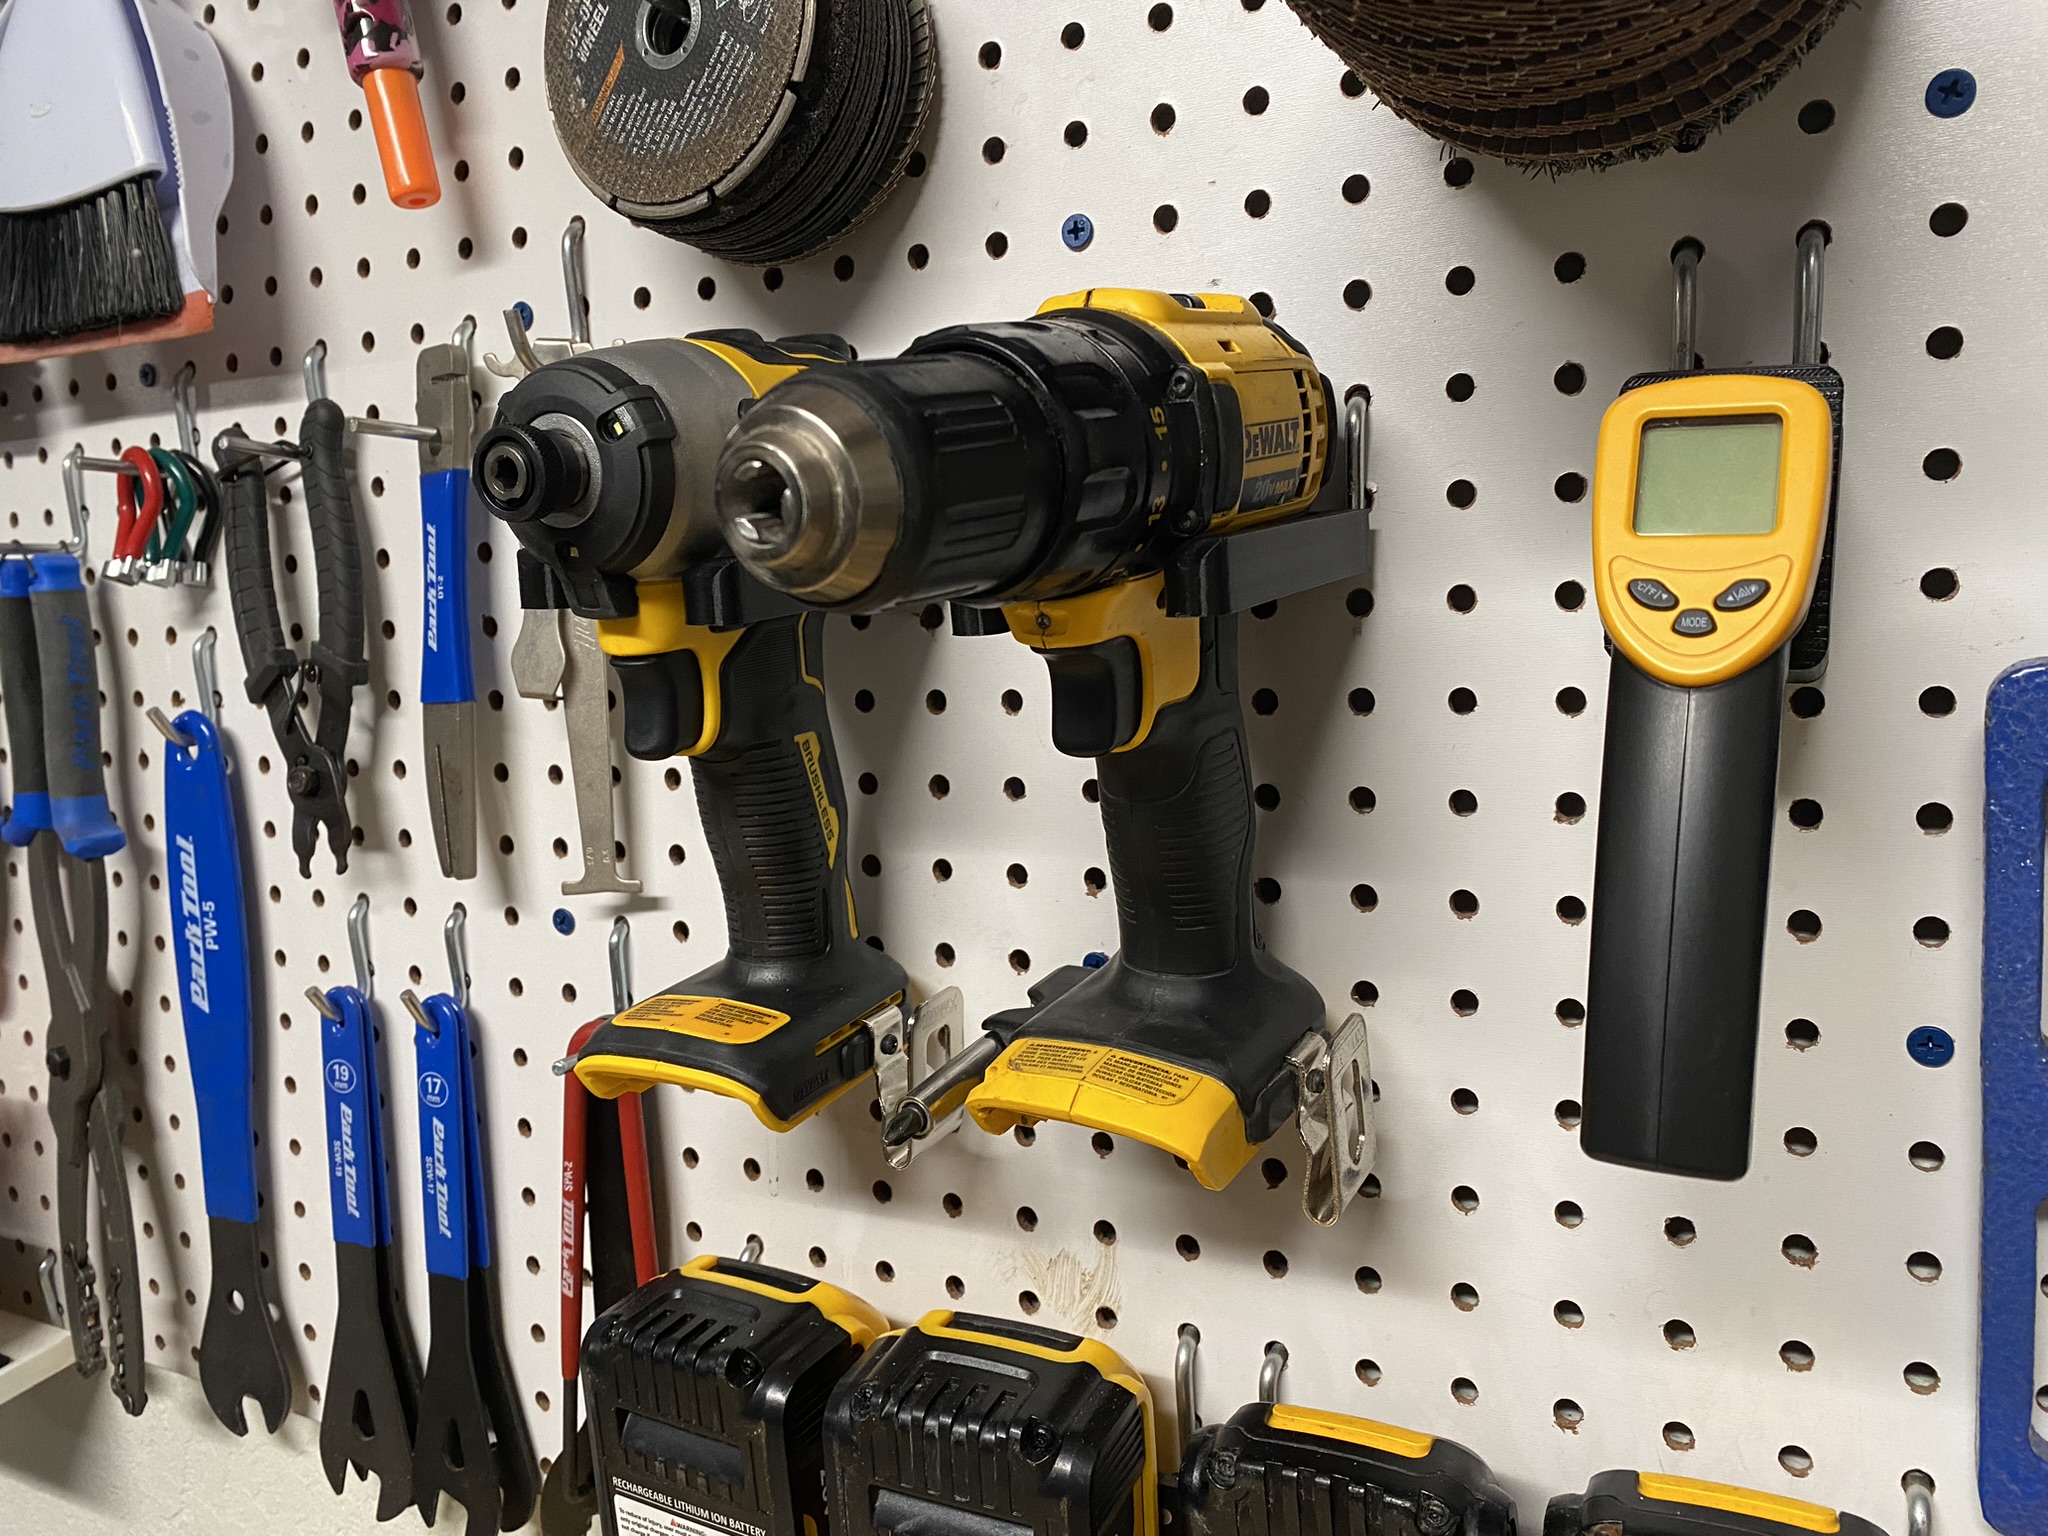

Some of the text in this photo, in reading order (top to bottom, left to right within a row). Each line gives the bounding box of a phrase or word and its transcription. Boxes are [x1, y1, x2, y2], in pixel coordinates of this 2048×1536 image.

[576, 4, 610, 63] WHEEL
[1150, 406, 1168, 440] 15
[427, 586, 437, 652] Park
[1681, 617, 1708, 628] MODE
[802, 739, 835, 842] BRUSHLESS
[176, 834, 210, 1013] Park Tool
[202, 900, 219, 950] PW-5
[333, 1064, 349, 1081] 19
[334, 1081, 348, 1090] mm
[425, 1076, 441, 1094] 17
[1173, 1072, 1189, 1080] PARA
[427, 1094, 440, 1103] mm
[340, 1102, 360, 1219] Park Tool
[425, 1156, 435, 1194] SCW-17
[433, 1116, 452, 1239] Park Tool
[563, 1161, 574, 1192] SPA-2
[612, 1476, 767, 1536] RECHARGEABLE LITHIUM ION BATTERY
